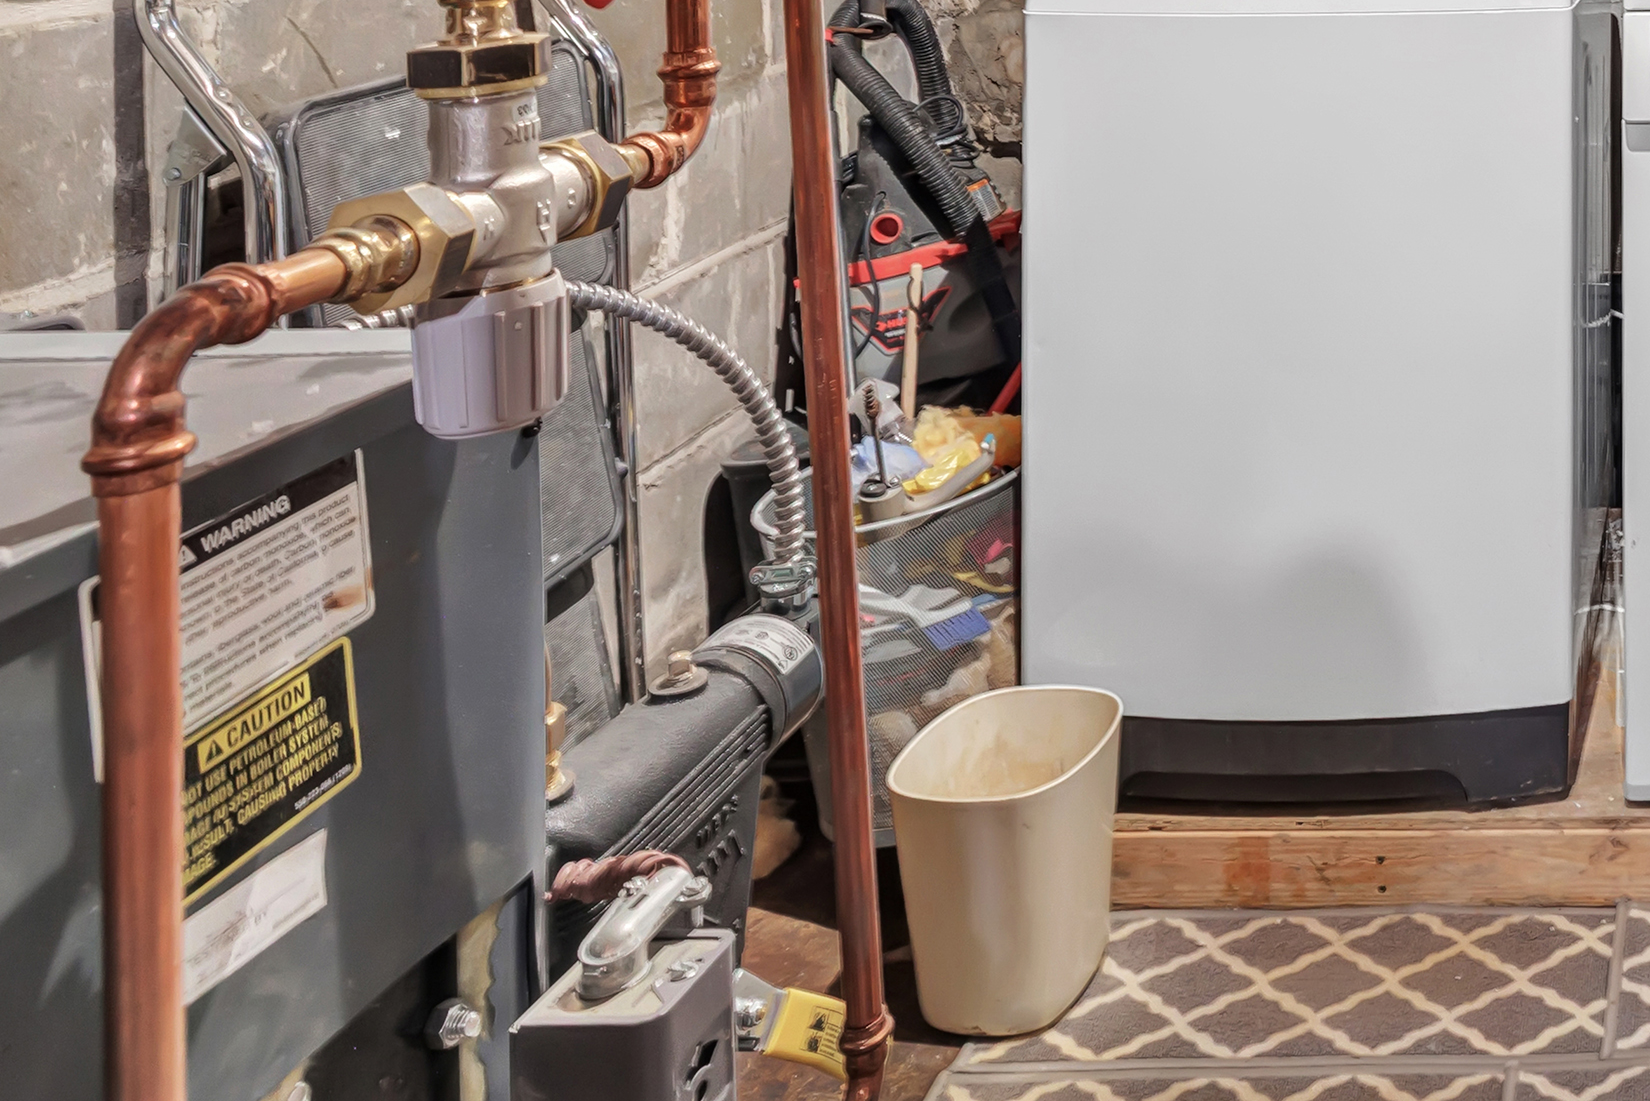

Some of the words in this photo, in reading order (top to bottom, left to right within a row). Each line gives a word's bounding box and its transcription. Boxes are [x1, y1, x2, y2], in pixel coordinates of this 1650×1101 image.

[200, 494, 292, 554] WARNING
[205, 764, 227, 792] USE
[229, 696, 327, 776] PETROLEUM-BASED
[226, 681, 305, 749] CAUTION
[250, 743, 288, 781] BOILER
[276, 721, 343, 782] COMPONENTS
[237, 781, 288, 826] CAUSING
[288, 742, 340, 792] PROPERTY
